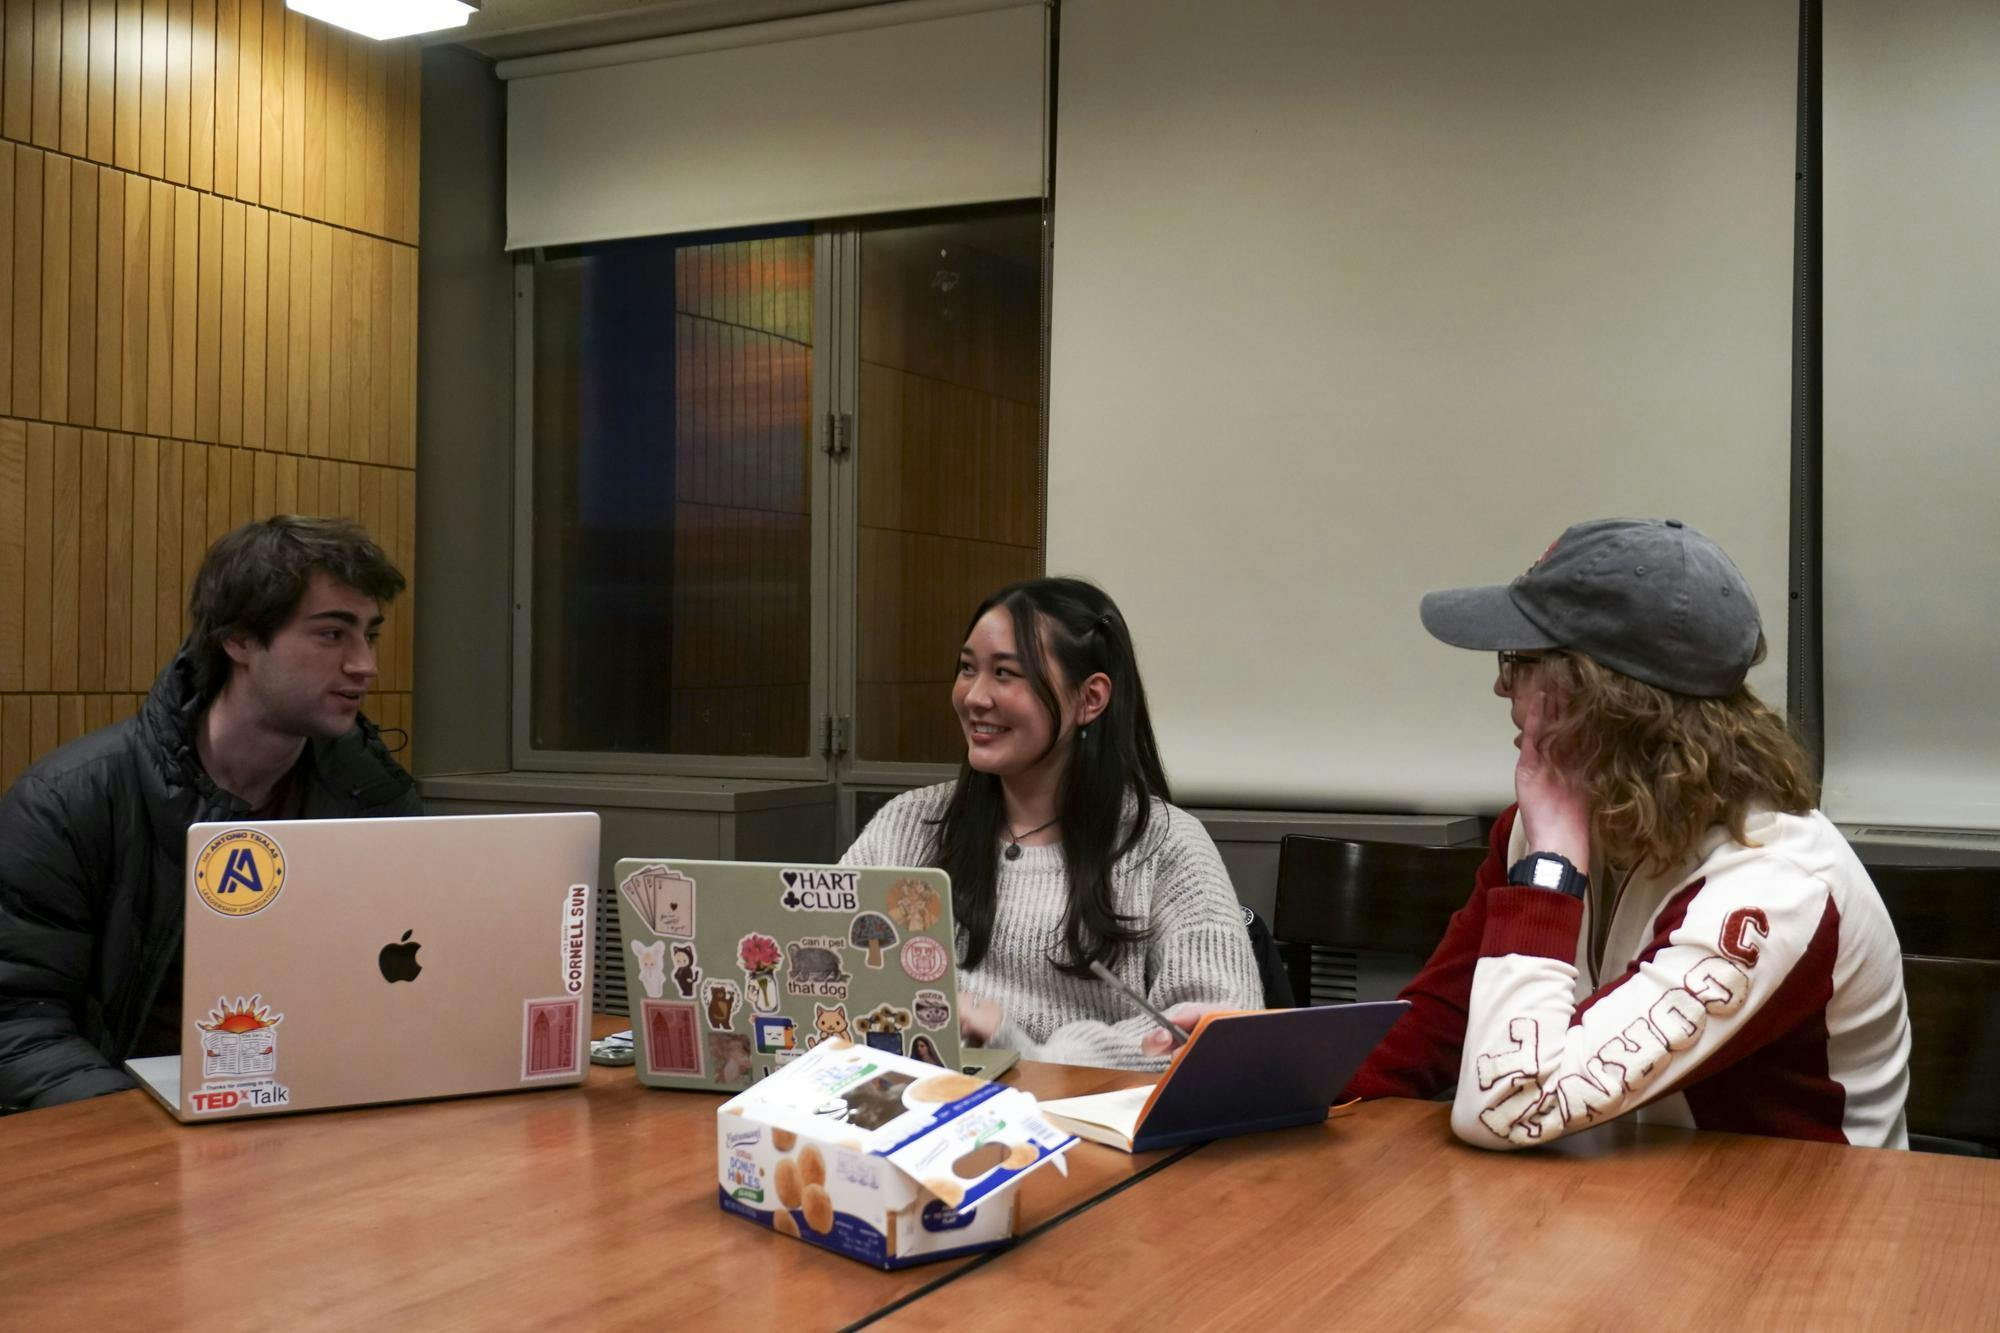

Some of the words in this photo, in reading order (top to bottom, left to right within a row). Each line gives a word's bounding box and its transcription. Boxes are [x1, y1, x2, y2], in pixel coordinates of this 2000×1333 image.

[210, 832, 247, 852] ANTONIO
[250, 833, 279, 859] TSIALAS
[798, 872, 857, 891] HART
[202, 888, 237, 913] LEADERSHIP
[239, 885, 278, 913] FOUNDATION
[571, 887, 586, 917] SUN
[800, 891, 856, 910] CLUB
[801, 938, 820, 946] can
[828, 938, 844, 948] pet
[1717, 906, 1770, 969] C
[568, 919, 585, 992] CORNELL
[788, 981, 816, 994] that
[819, 982, 847, 999] dog
[250, 1085, 288, 1105] Talk
